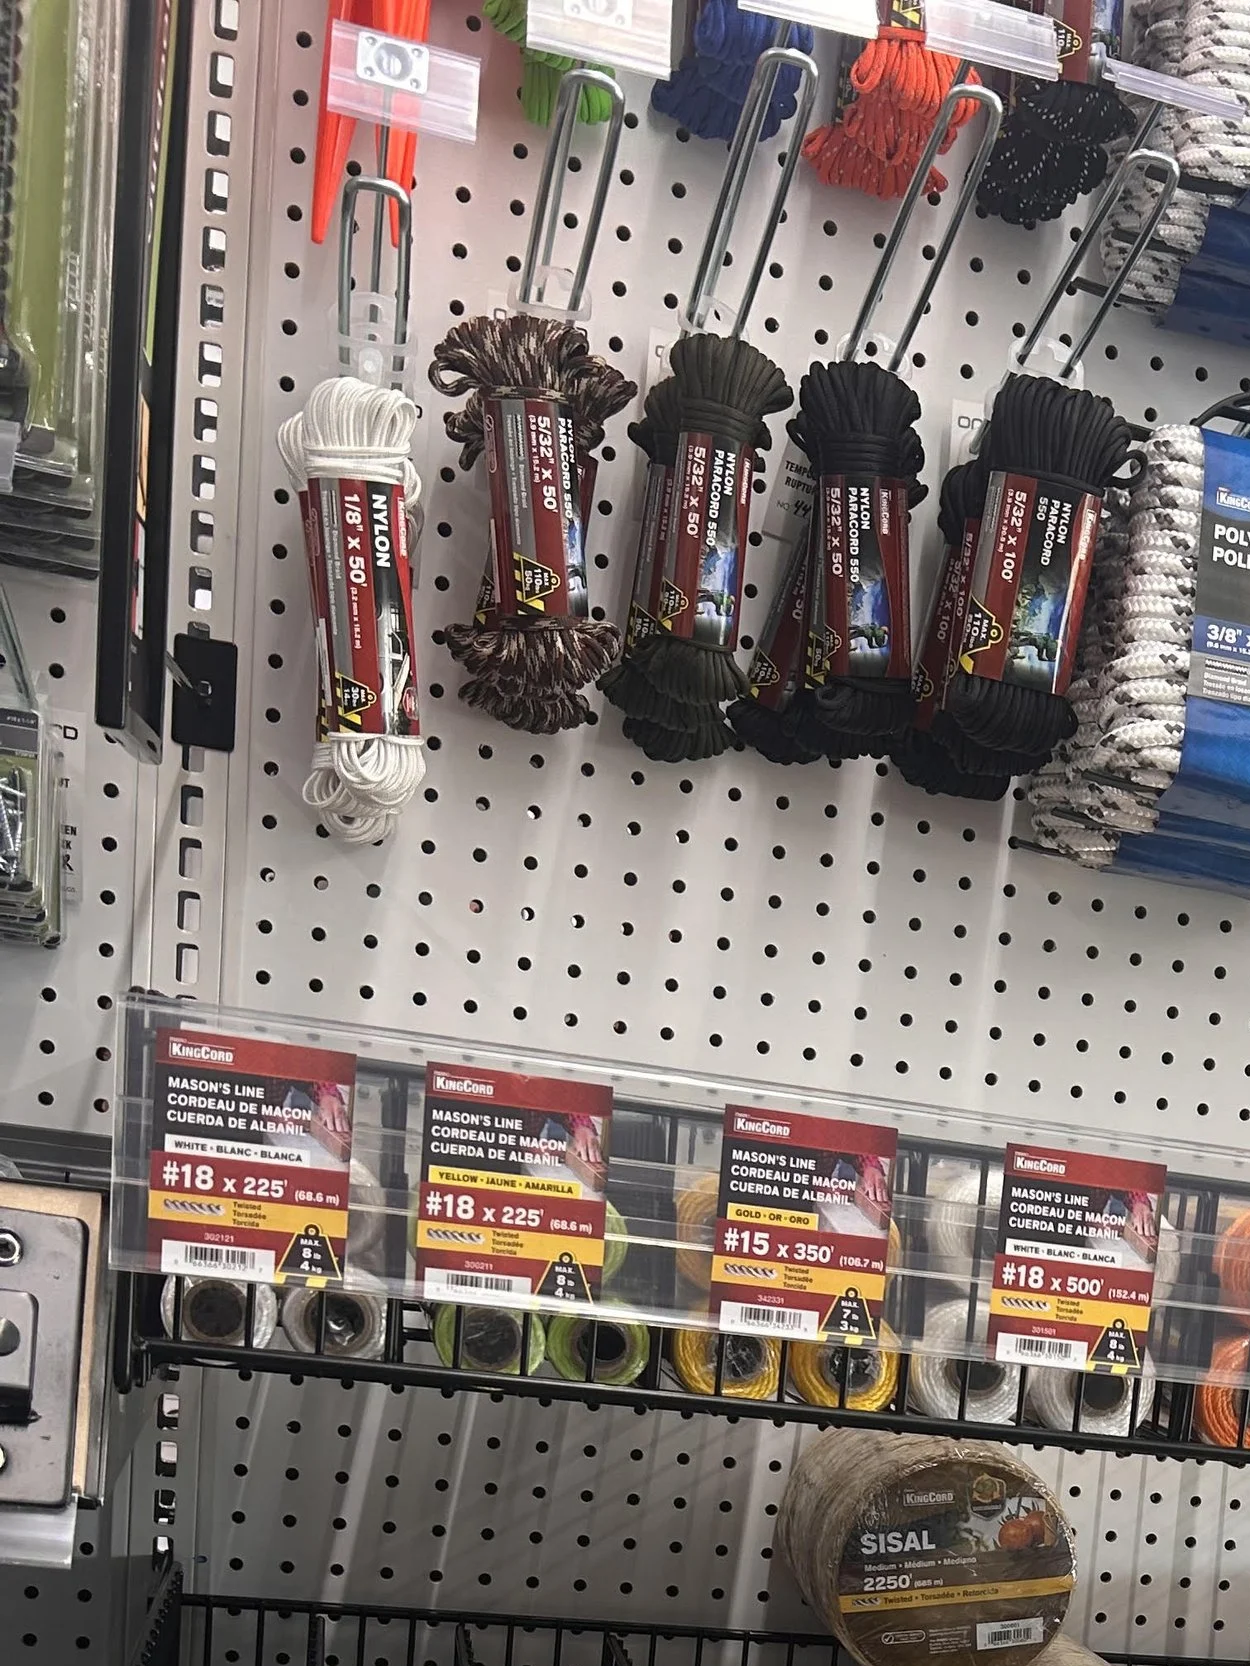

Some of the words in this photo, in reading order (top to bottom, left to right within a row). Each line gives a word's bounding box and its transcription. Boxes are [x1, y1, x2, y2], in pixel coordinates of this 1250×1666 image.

[344, 494, 364, 532] 1/8"
[1010, 491, 1027, 533] 5/32"
[1056, 502, 1072, 545] NYLON
[371, 494, 391, 568] NYLON
[1040, 500, 1061, 567] PARACORD
[348, 556, 367, 587] 50'
[1001, 552, 1016, 583] 100'
[1207, 625, 1243, 644] 3/8"
[168, 1077, 230, 1095] MASON'S
[233, 1084, 265, 1099] LINE
[167, 1093, 236, 1113] CORDEAU
[238, 1101, 257, 1116] DE
[261, 1106, 312, 1124] MAÇON
[167, 1110, 225, 1127] CUERDA
[227, 1117, 247, 1130] DE
[250, 1115, 306, 1137] ALBAÑIL
[174, 1140, 208, 1153] WHITE
[217, 1145, 252, 1158] BLANC
[261, 1151, 302, 1163] BLANCA
[162, 1163, 214, 1191] #18
[223, 1178, 237, 1193] x
[242, 1175, 288, 1199] 225'
[295, 1189, 324, 1204] (68.6
[327, 1193, 341, 1205] m)
[439, 1171, 477, 1184] YELLOW
[525, 1180, 573, 1194] AMARILLA
[426, 1191, 475, 1220] #18
[483, 1208, 496, 1222] x
[501, 1205, 545, 1228] 225'
[735, 1209, 764, 1220] GOLD
[768, 1212, 783, 1222] OR
[790, 1215, 810, 1225] ORO
[724, 1228, 770, 1256] #15
[777, 1244, 790, 1258] x
[794, 1242, 834, 1264] 350'
[839, 1255, 869, 1268] (106.7
[861, 1530, 936, 1555] SISAL
[864, 1574, 912, 1591] 2250'
